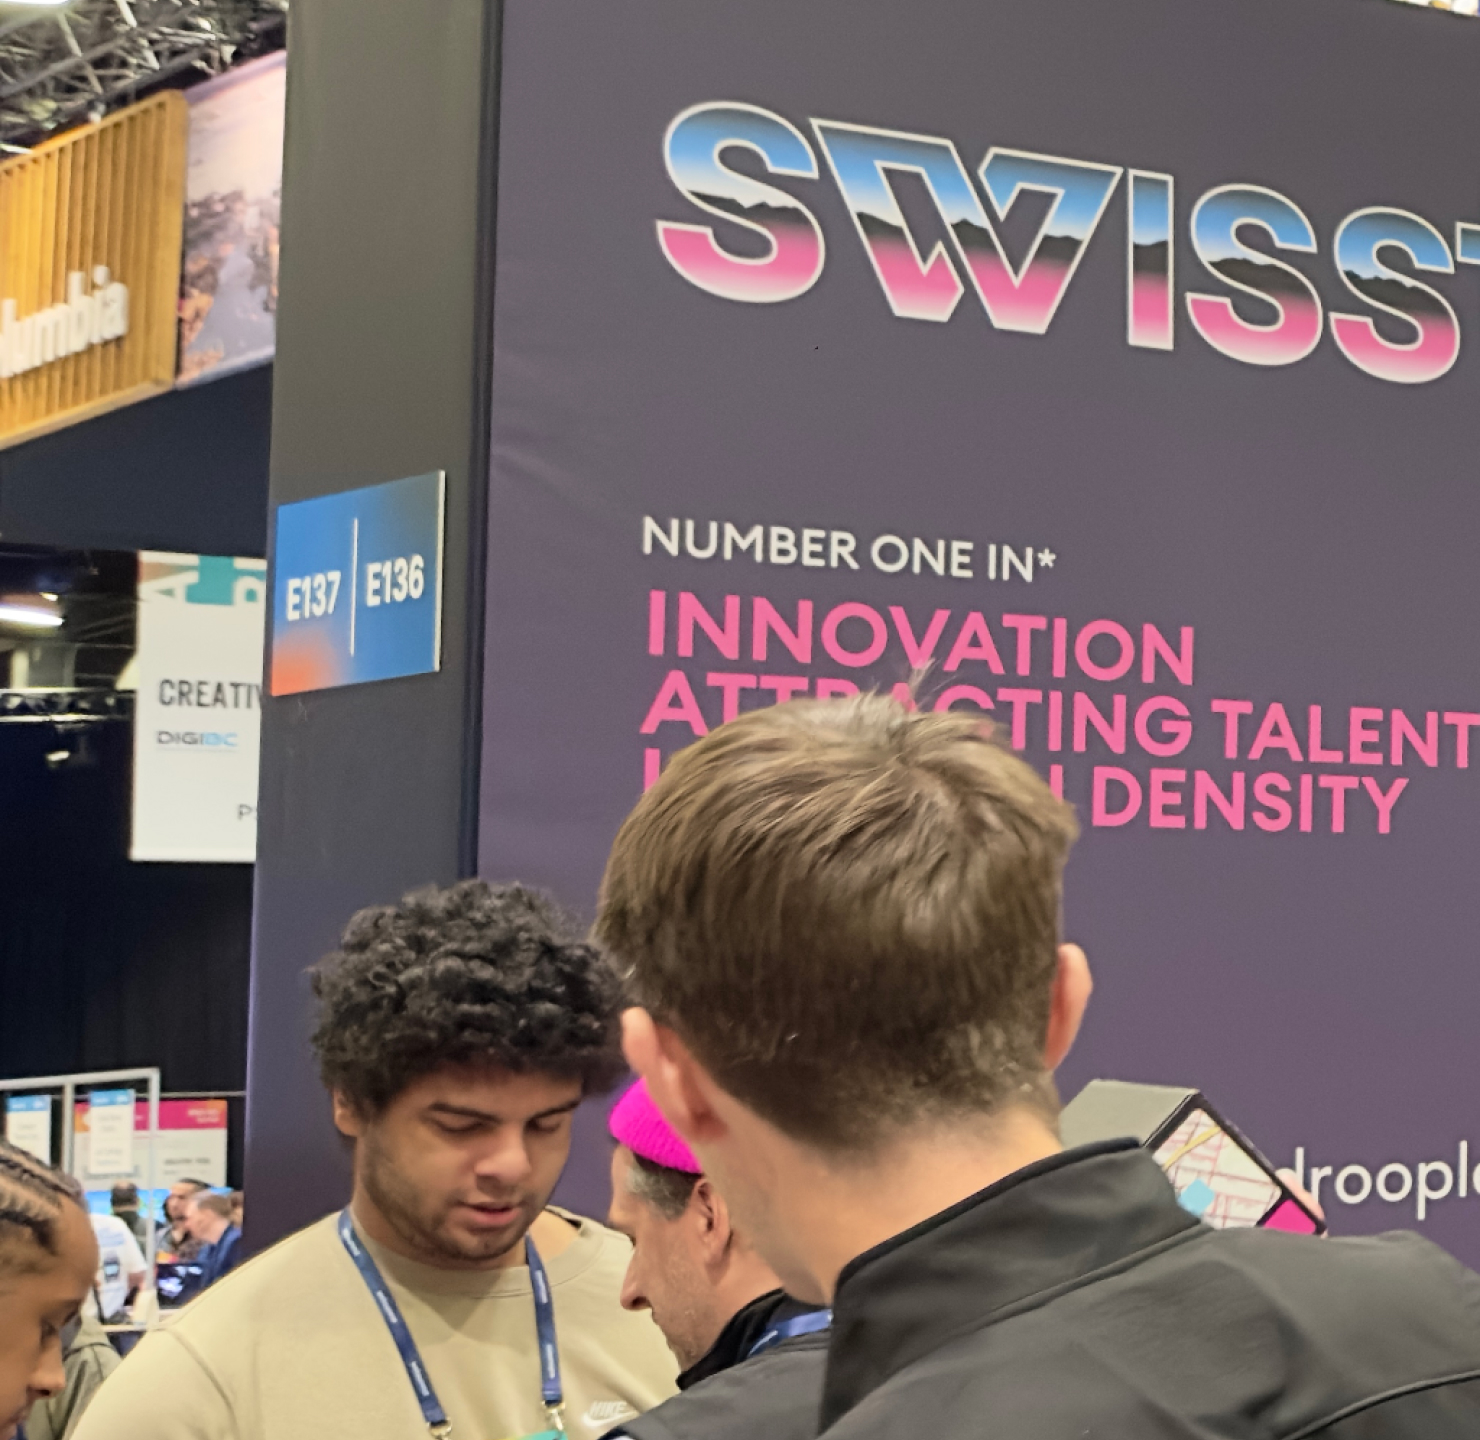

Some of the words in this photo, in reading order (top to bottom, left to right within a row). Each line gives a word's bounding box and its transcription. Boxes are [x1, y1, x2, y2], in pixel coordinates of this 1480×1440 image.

[0, 265, 128, 378] lumbia
[642, 516, 860, 570] NUMBER
[871, 535, 973, 578] ONE
[287, 570, 341, 621] E137
[366, 554, 424, 607] E136
[648, 589, 1194, 686] INNOVATION
[1092, 766, 1409, 834] DENSITY
[589, 1401, 627, 1417] NIKE
